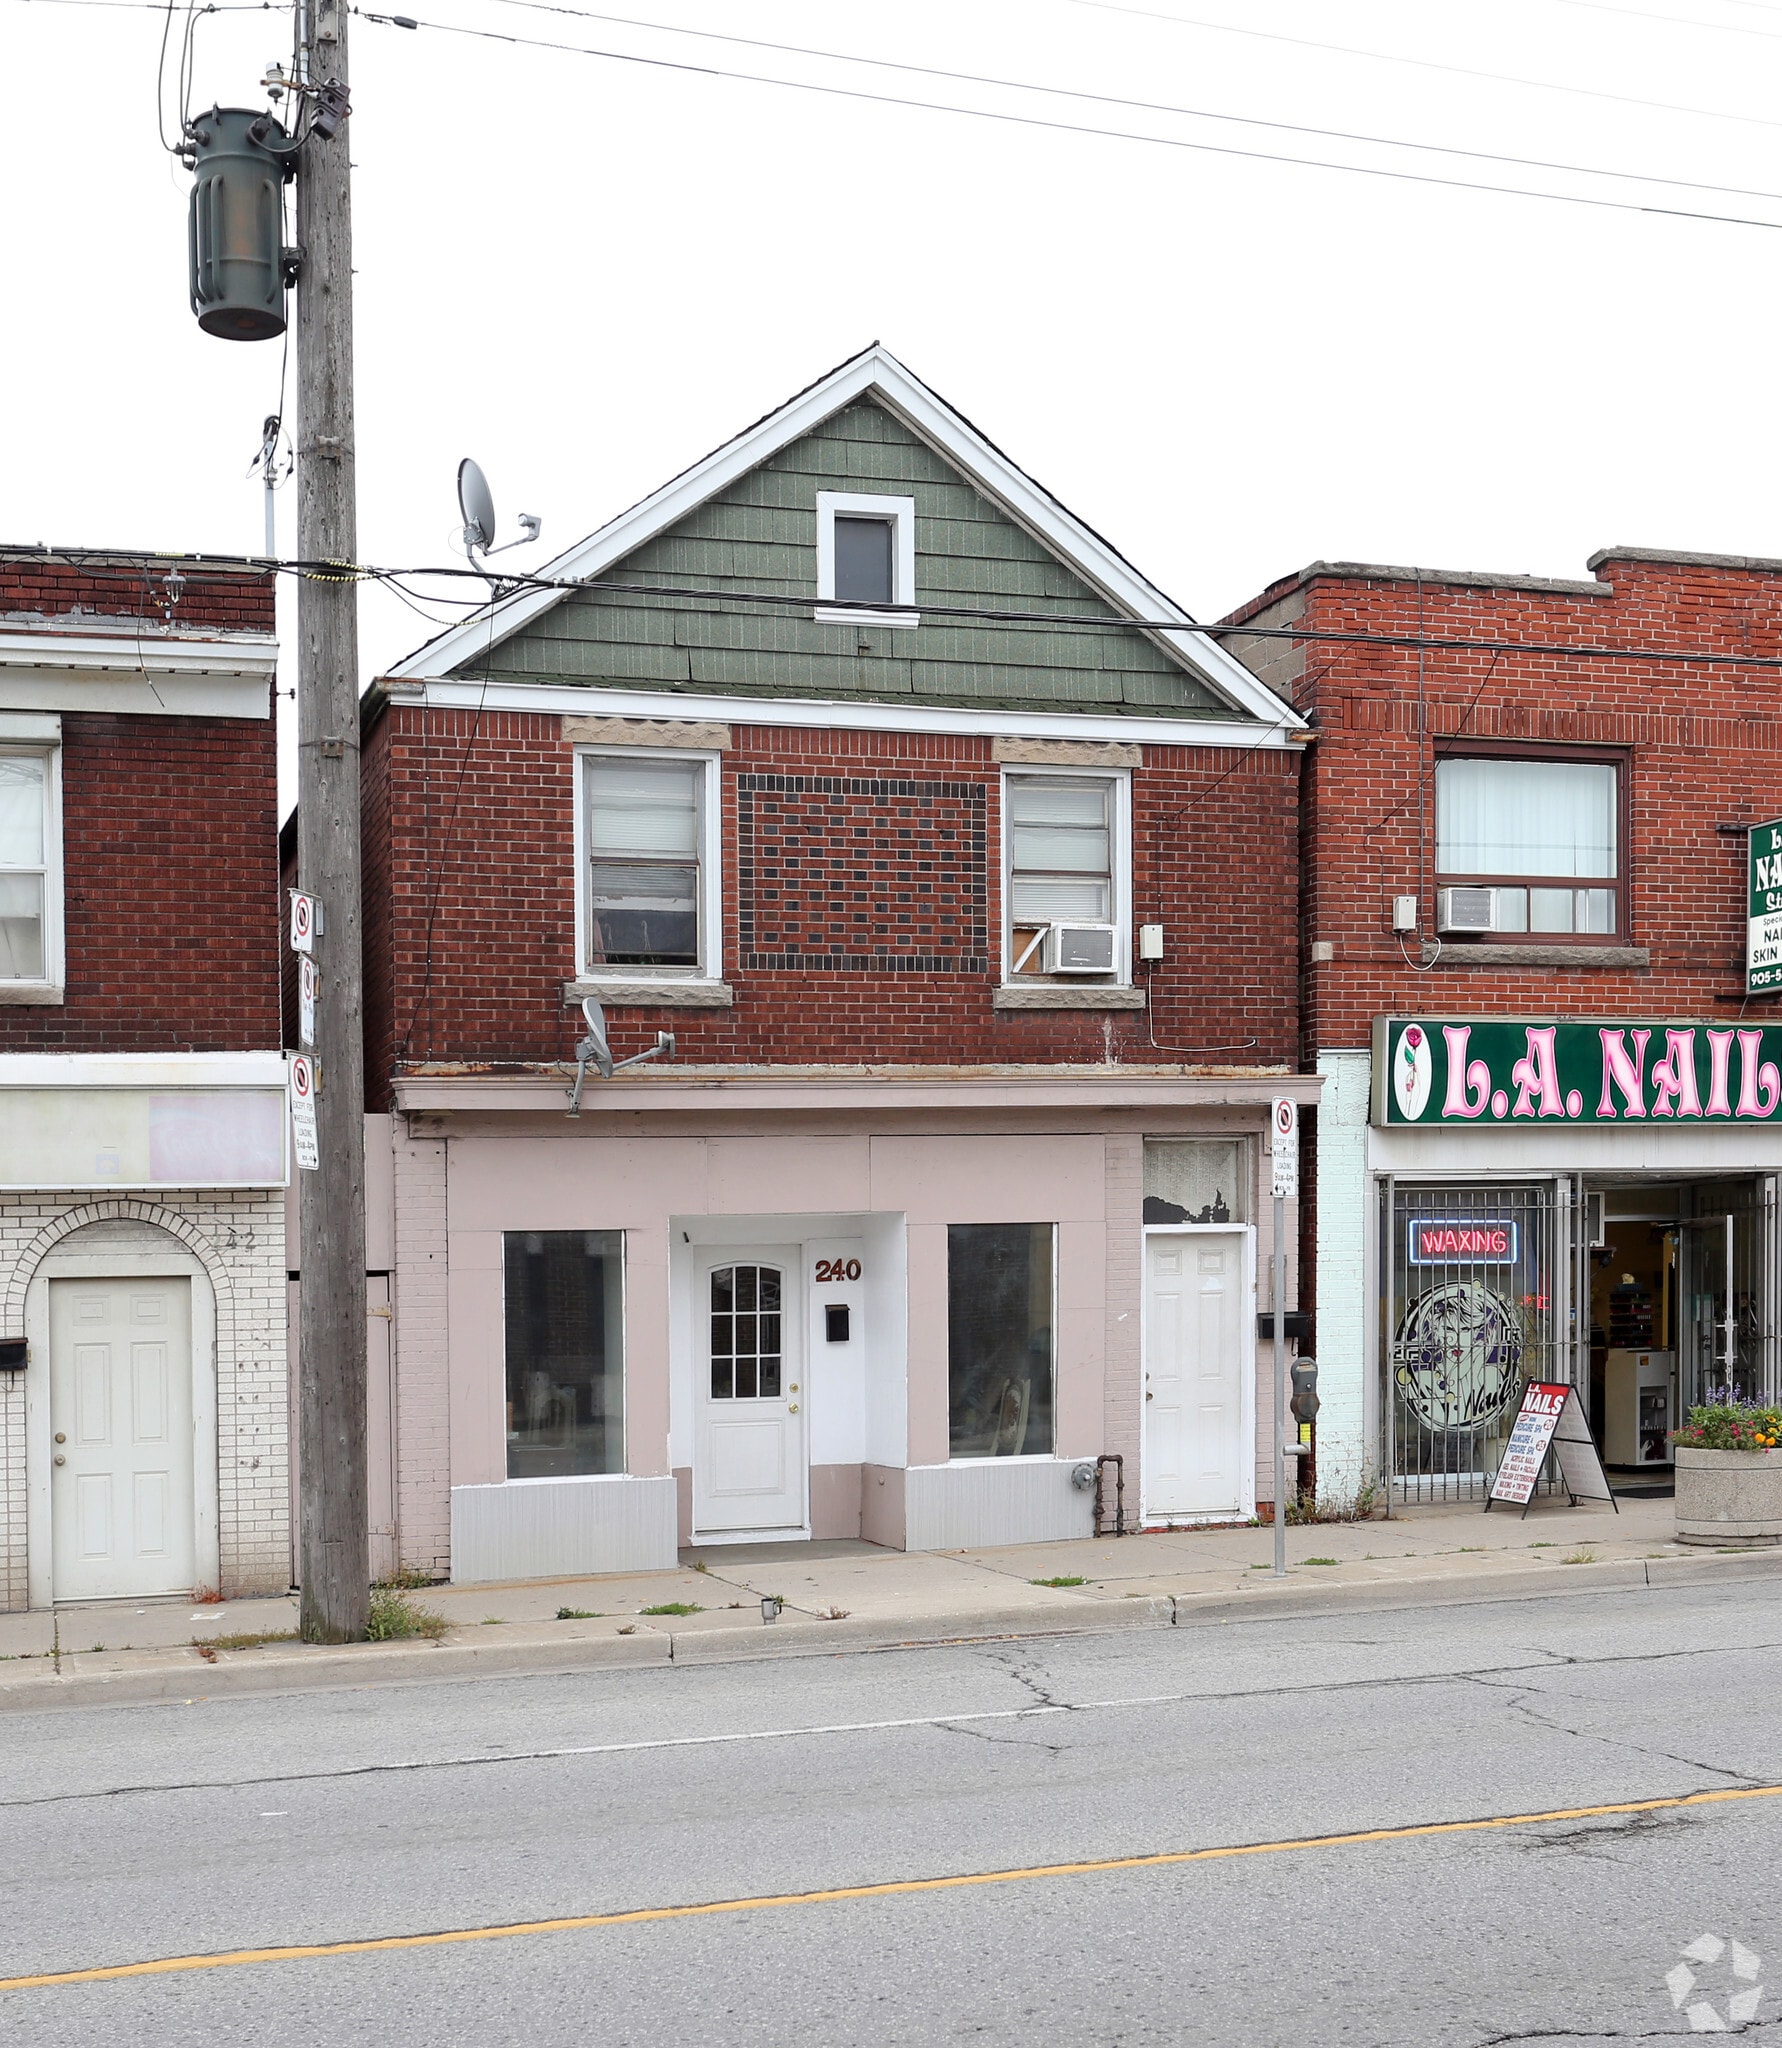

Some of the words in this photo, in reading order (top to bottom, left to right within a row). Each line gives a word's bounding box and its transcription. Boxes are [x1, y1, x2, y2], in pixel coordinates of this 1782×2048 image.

[1753, 946, 1778, 963] SKIN
[1442, 1025, 1583, 1118] L.A.
[1277, 1161, 1292, 1170] LOADING
[1422, 1230, 1507, 1253] WAXING
[815, 1258, 861, 1282] 240
[1528, 1383, 1541, 1393] L.A.
[1521, 1392, 1564, 1415] NAILS
